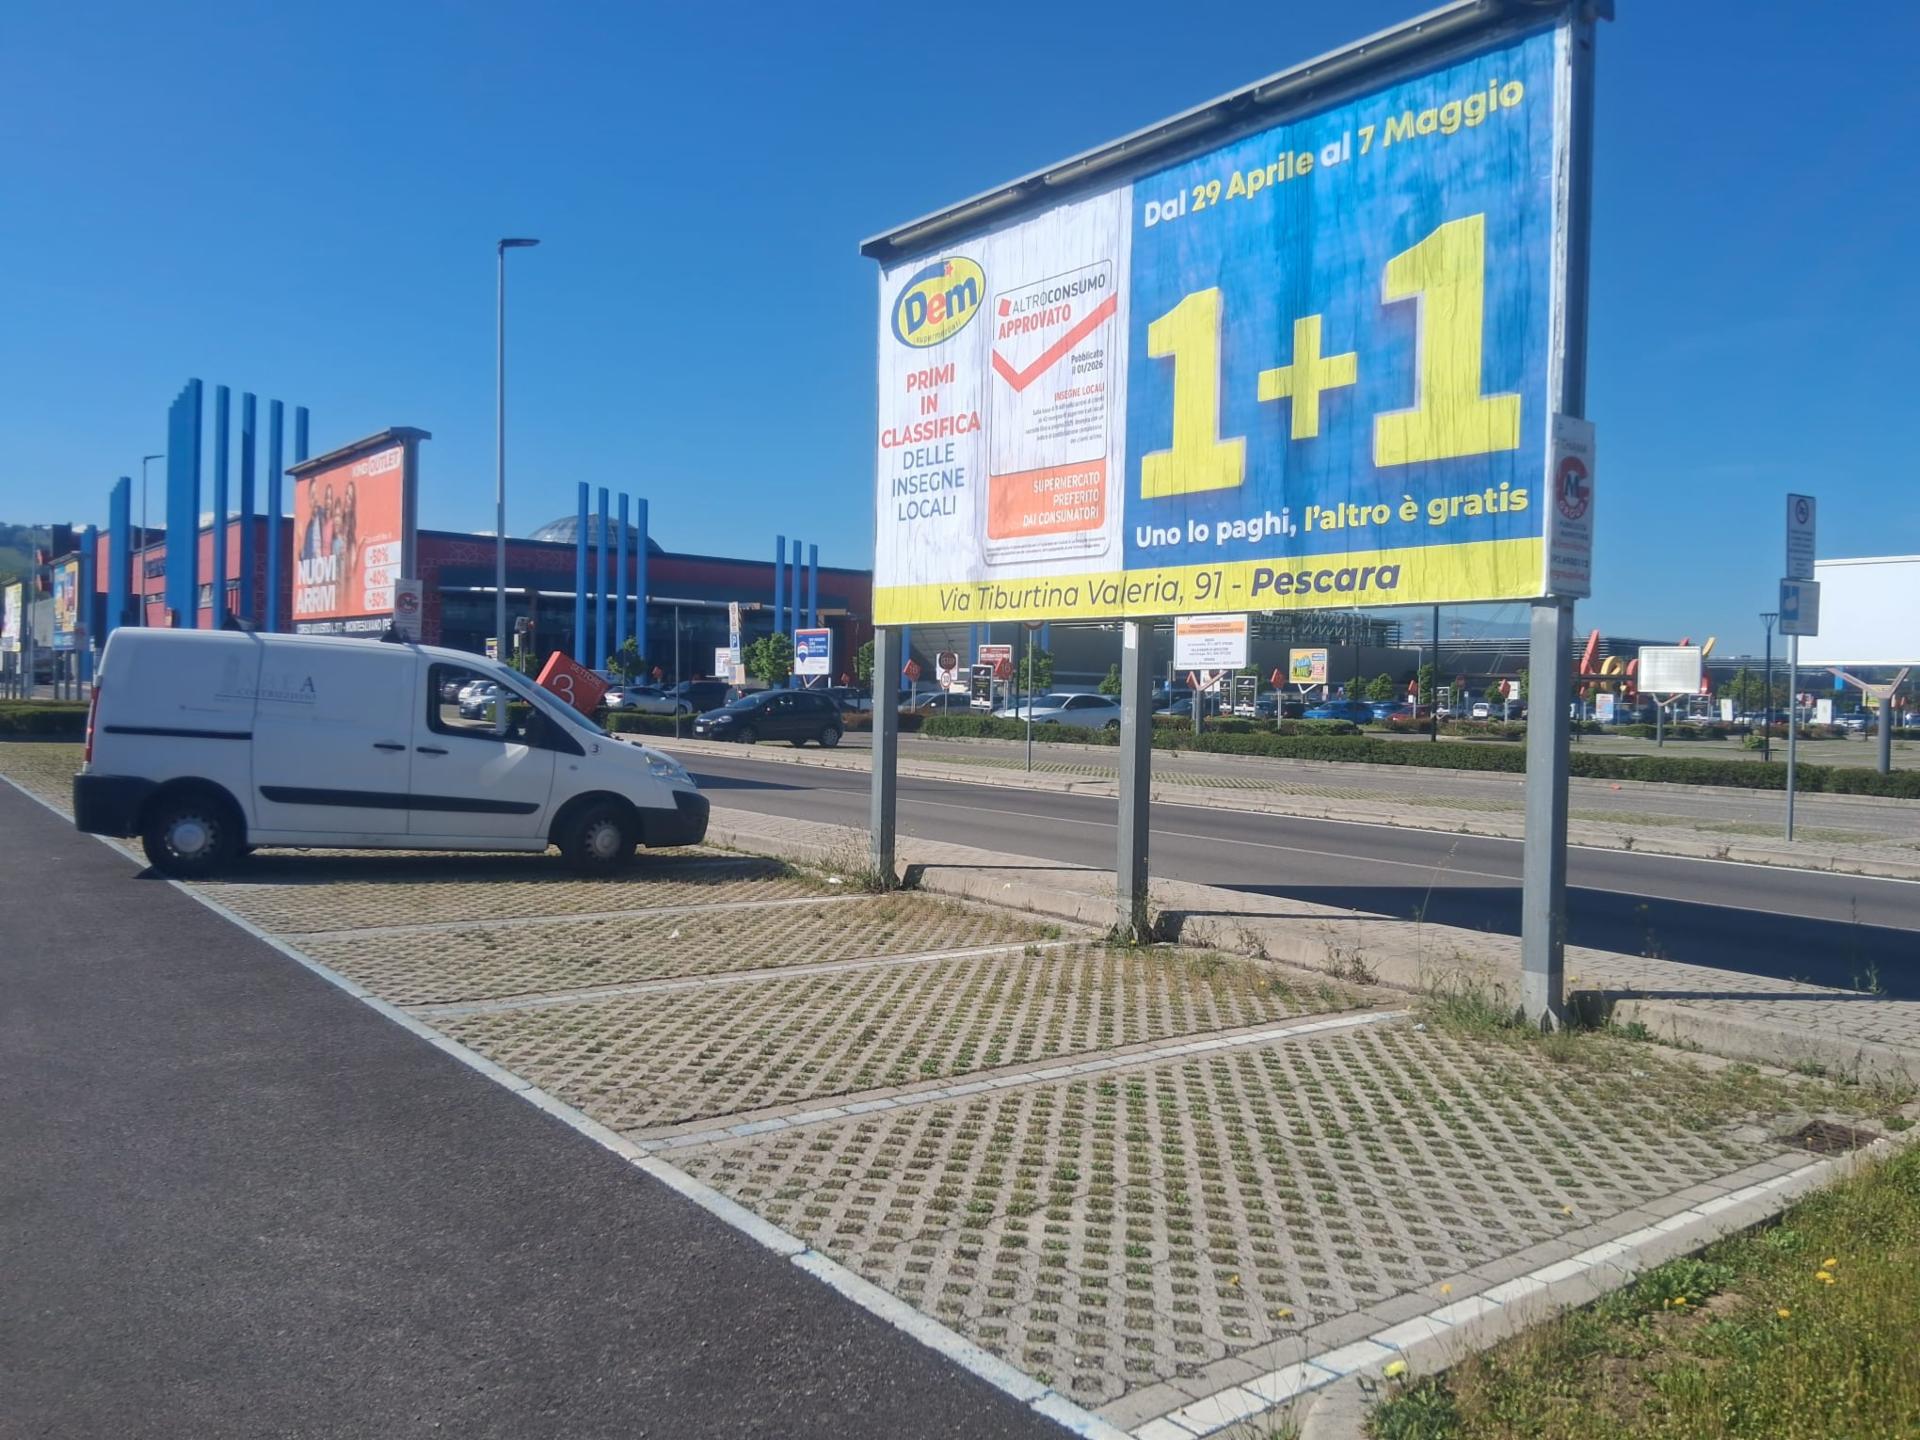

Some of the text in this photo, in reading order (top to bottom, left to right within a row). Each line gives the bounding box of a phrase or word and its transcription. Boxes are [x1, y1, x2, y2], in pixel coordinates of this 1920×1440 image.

[1144, 78, 1524, 228] Dal 29 Aprile al 7 Maggio
[904, 276, 978, 336] Dem
[1012, 273, 1106, 315] ALTROCONSUMO
[999, 303, 1071, 341] APPROVATO
[1071, 349, 1104, 364] Pubblicato
[1077, 360, 1104, 375] 01/2026
[906, 362, 955, 393] PRIMI
[1055, 382, 1105, 402] INSEGNE LOCALI
[920, 394, 938, 416] IN
[881, 411, 981, 449] CLASSIFICA
[903, 442, 955, 470] DELLE
[892, 468, 965, 497] INSEGNE
[1033, 471, 1101, 494] SUPERMERCATO
[898, 496, 956, 522] LOCALI
[1053, 491, 1099, 507] PREFERITO
[1023, 508, 1099, 528] DAI CONSUMATORI
[1136, 524, 1181, 549] Uno
[1188, 519, 1209, 543] lo
[1216, 507, 1297, 545] paghi,
[1399, 494, 1418, 522] è
[1428, 481, 1528, 525] gratis
[298, 554, 337, 586] NUOVI
[296, 584, 336, 614] ARRIVI
[940, 587, 970, 611] Via
[977, 581, 1079, 610] Tiburtina
[1088, 575, 1185, 607] Valeria,
[1194, 570, 1222, 600] 91
[1251, 562, 1401, 597] Pescara
[552, 673, 575, 705] 3
